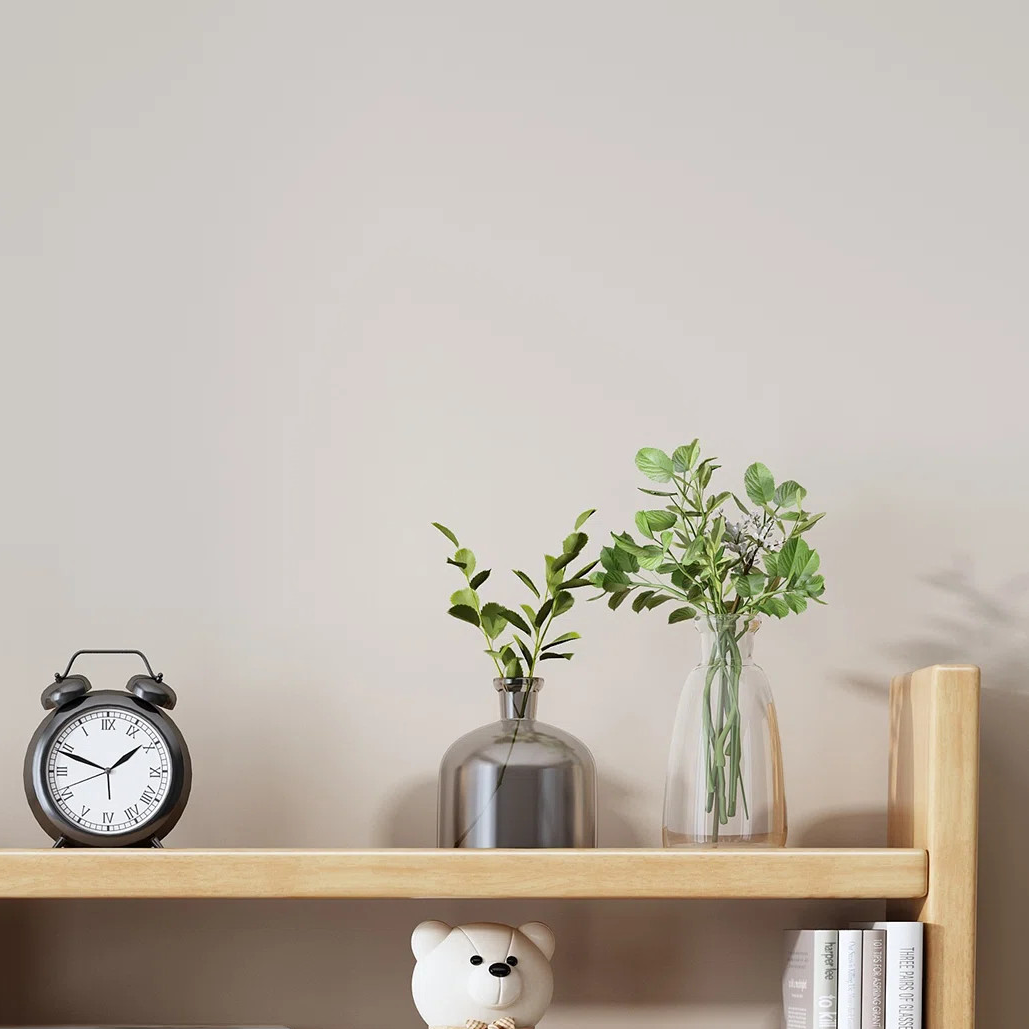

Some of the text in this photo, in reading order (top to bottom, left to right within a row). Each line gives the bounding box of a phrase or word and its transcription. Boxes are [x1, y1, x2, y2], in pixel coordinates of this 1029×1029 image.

[821, 942, 837, 981] harper lee
[899, 947, 915, 969] THREE
[899, 971, 915, 991] PAIRS
[818, 994, 836, 1008] to
[899, 993, 914, 1002] OF
[818, 1011, 837, 1028] kill
